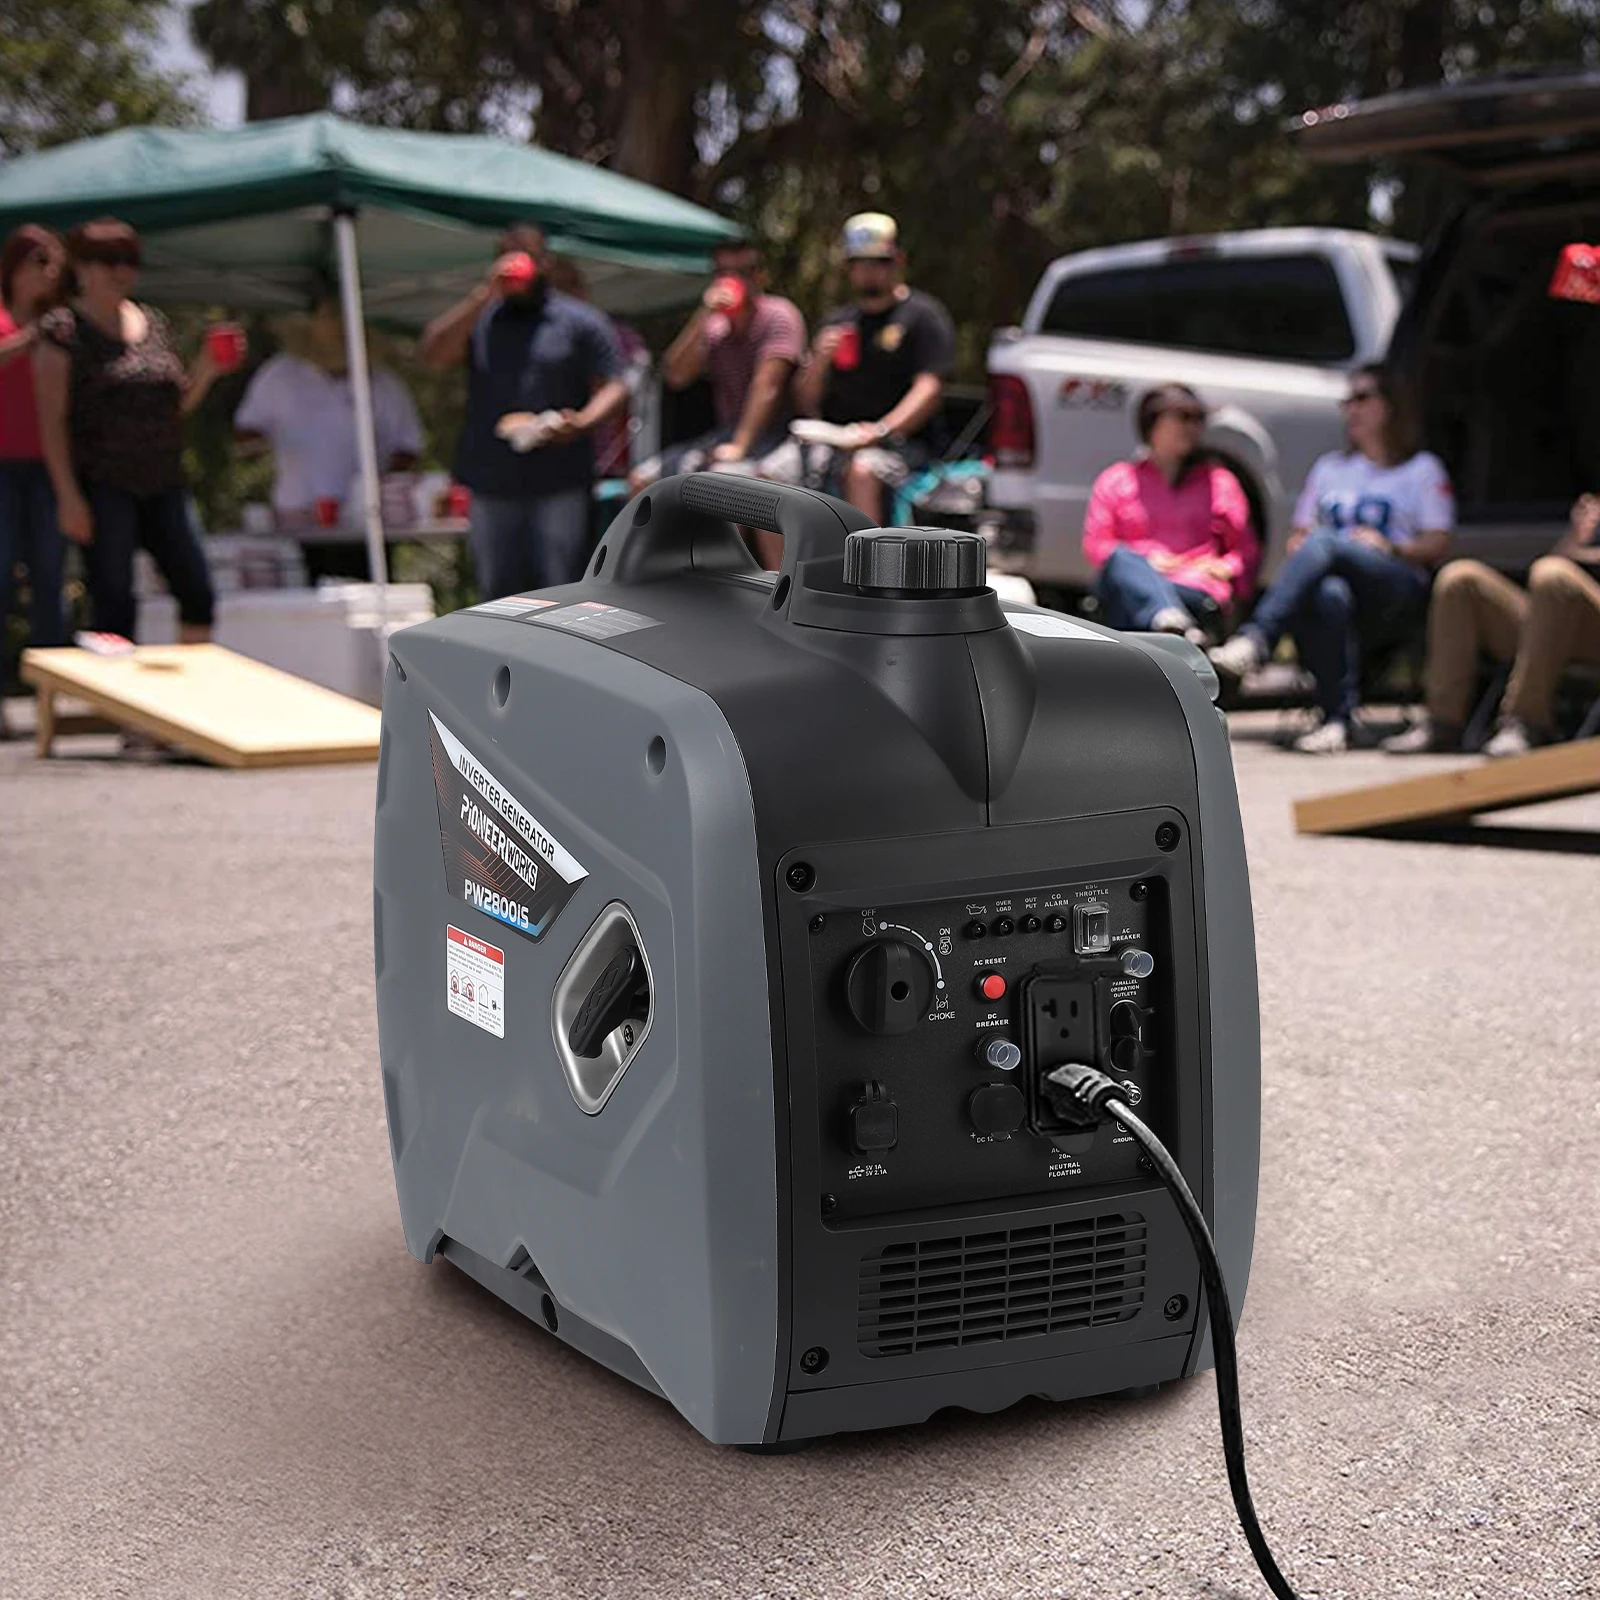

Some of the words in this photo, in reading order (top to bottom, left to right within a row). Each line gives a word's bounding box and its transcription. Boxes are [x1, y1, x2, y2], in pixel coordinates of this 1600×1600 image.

[459, 754, 501, 808] INVERTER
[501, 798, 555, 861] GENERATOR
[1075, 888, 1109, 898] THROTTLE
[1044, 899, 1069, 908] ALARM
[861, 909, 877, 917] OFF
[939, 928, 951, 936] ON
[1111, 933, 1141, 942] BREAKER
[984, 957, 1007, 965] RESET
[1110, 984, 1140, 993] OPERATION
[928, 1011, 956, 1021] CHOKE
[975, 1018, 1009, 1028] BREAKER
[1112, 1136, 1135, 1144] GROUN
[1049, 1161, 1081, 1171] NEUTRAL
[1048, 1168, 1082, 1178] FLOATING
